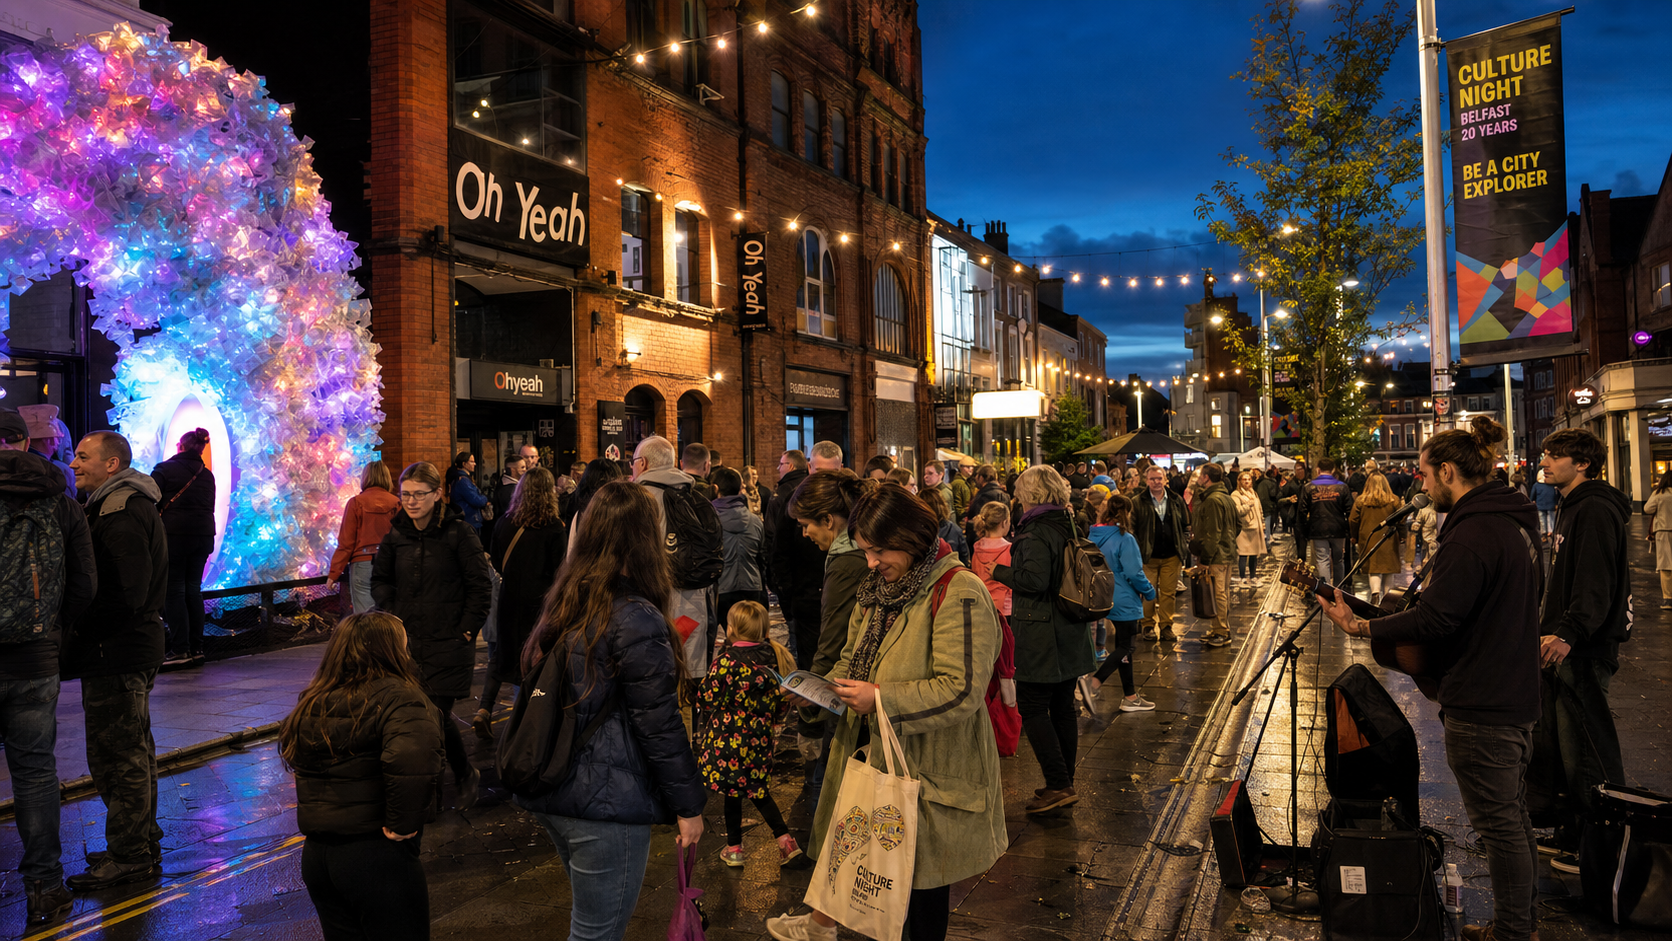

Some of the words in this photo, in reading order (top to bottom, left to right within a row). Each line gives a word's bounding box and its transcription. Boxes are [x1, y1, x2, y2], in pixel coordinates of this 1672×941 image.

[1458, 44, 1552, 85] CULTURE
[1459, 75, 1524, 109] NIGHT
[1460, 103, 1511, 126] BELFAST
[1461, 126, 1476, 141] 20
[1478, 118, 1518, 137] YEARS
[1462, 162, 1482, 181] BE
[1486, 159, 1498, 176] A
[1501, 151, 1541, 173] CITY
[1463, 169, 1548, 199] EXPLORER
[455, 161, 503, 223] Oh
[515, 181, 586, 246] Yeah
[743, 240, 764, 266] Oh
[742, 271, 766, 315] Yeah
[494, 371, 543, 395] Ohyeah
[854, 876, 881, 897] NIGHT
